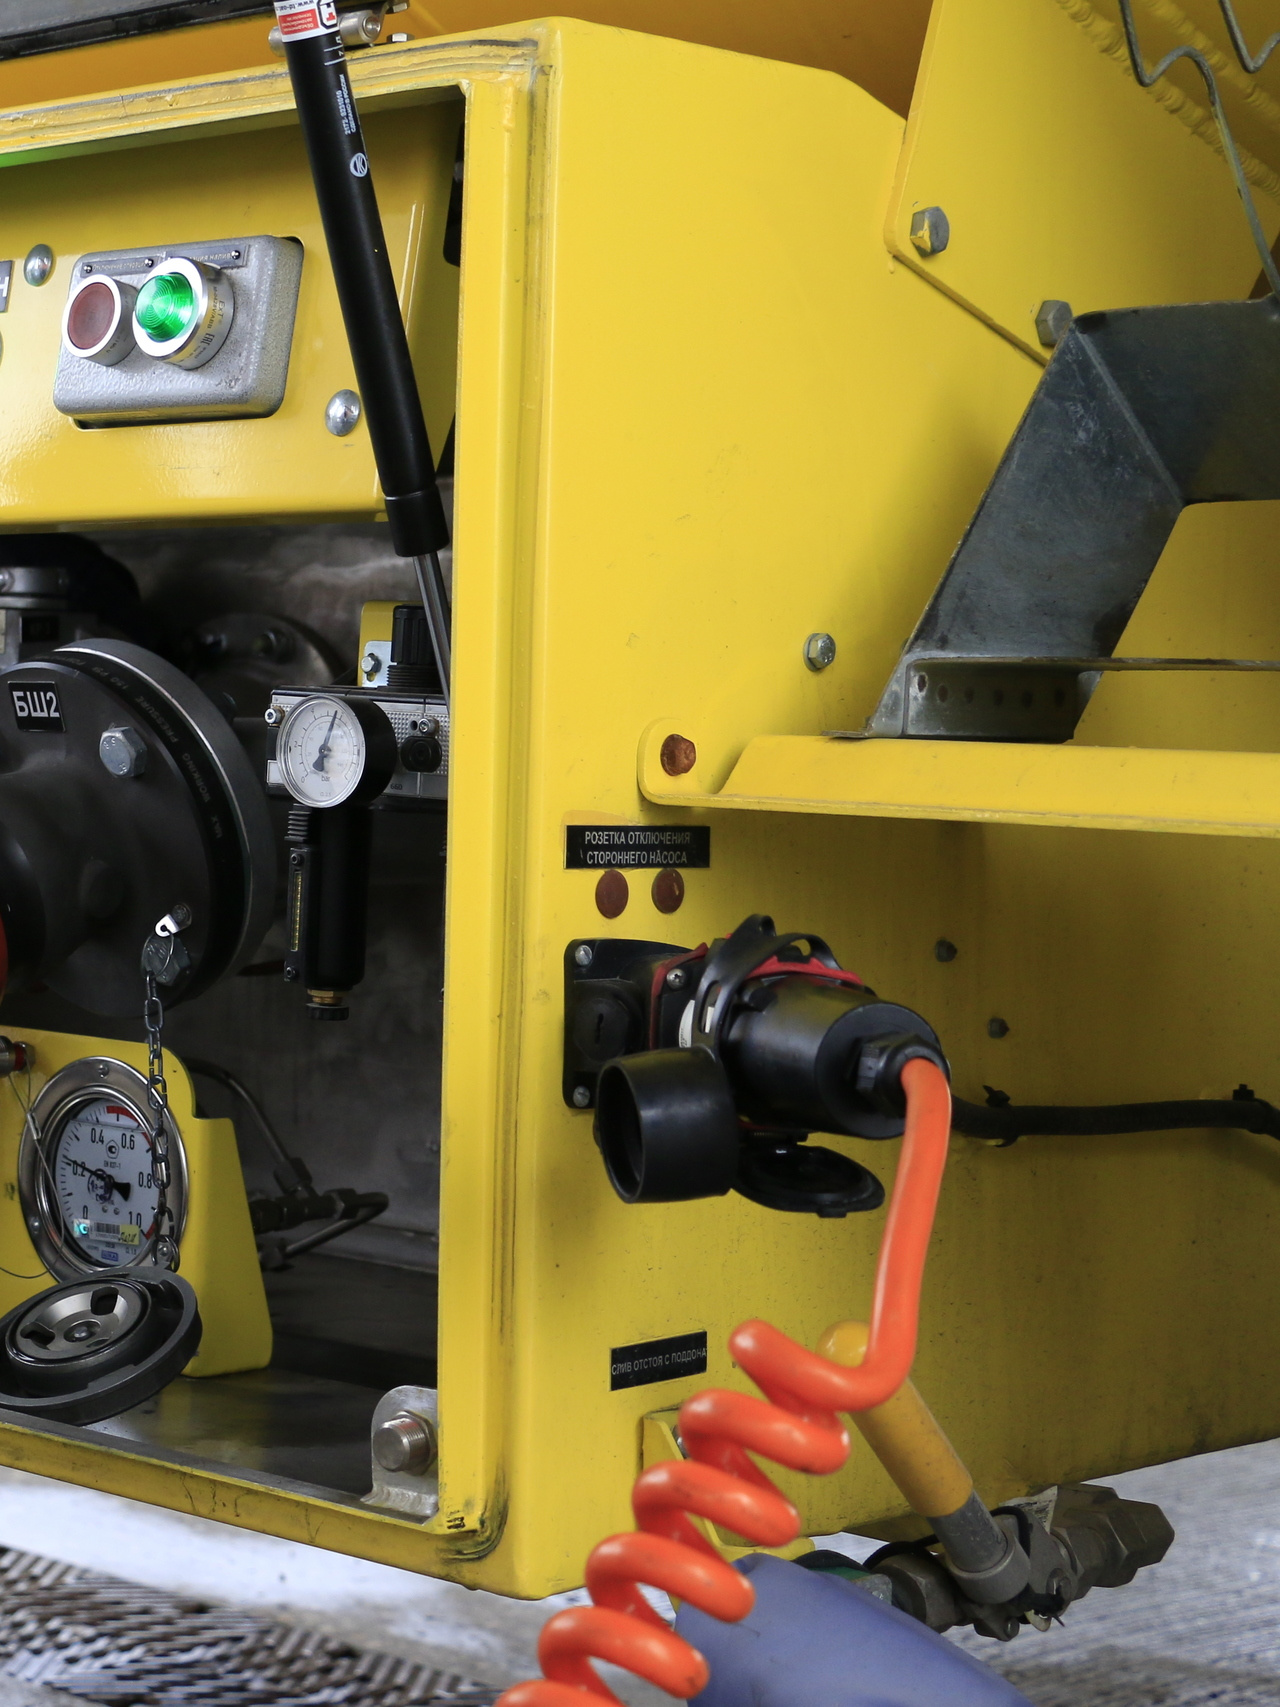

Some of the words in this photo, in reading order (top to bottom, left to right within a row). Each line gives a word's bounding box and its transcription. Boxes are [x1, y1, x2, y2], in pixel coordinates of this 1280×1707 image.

[12, 690, 60, 718] БШ2
[135, 696, 179, 743] PRESSURE
[321, 774, 331, 782] bar
[585, 832, 625, 844] РОЗЕТКА
[628, 831, 691, 844] ОТКЛЮЧЕНИЯ
[587, 851, 647, 865] СТОРОННЕГО
[650, 850, 687, 864] НАСОСА
[91, 1127, 104, 1145] 0.4
[121, 1132, 135, 1150] 0.6
[72, 1160, 86, 1177] 0.2
[138, 1171, 152, 1189] 0.8
[82, 1205, 89, 1220] 0
[612, 1361, 632, 1375] СЛИВ
[634, 1355, 663, 1371] ОТСТОЯ
[672, 1347, 706, 1364] ПОДДОНА
